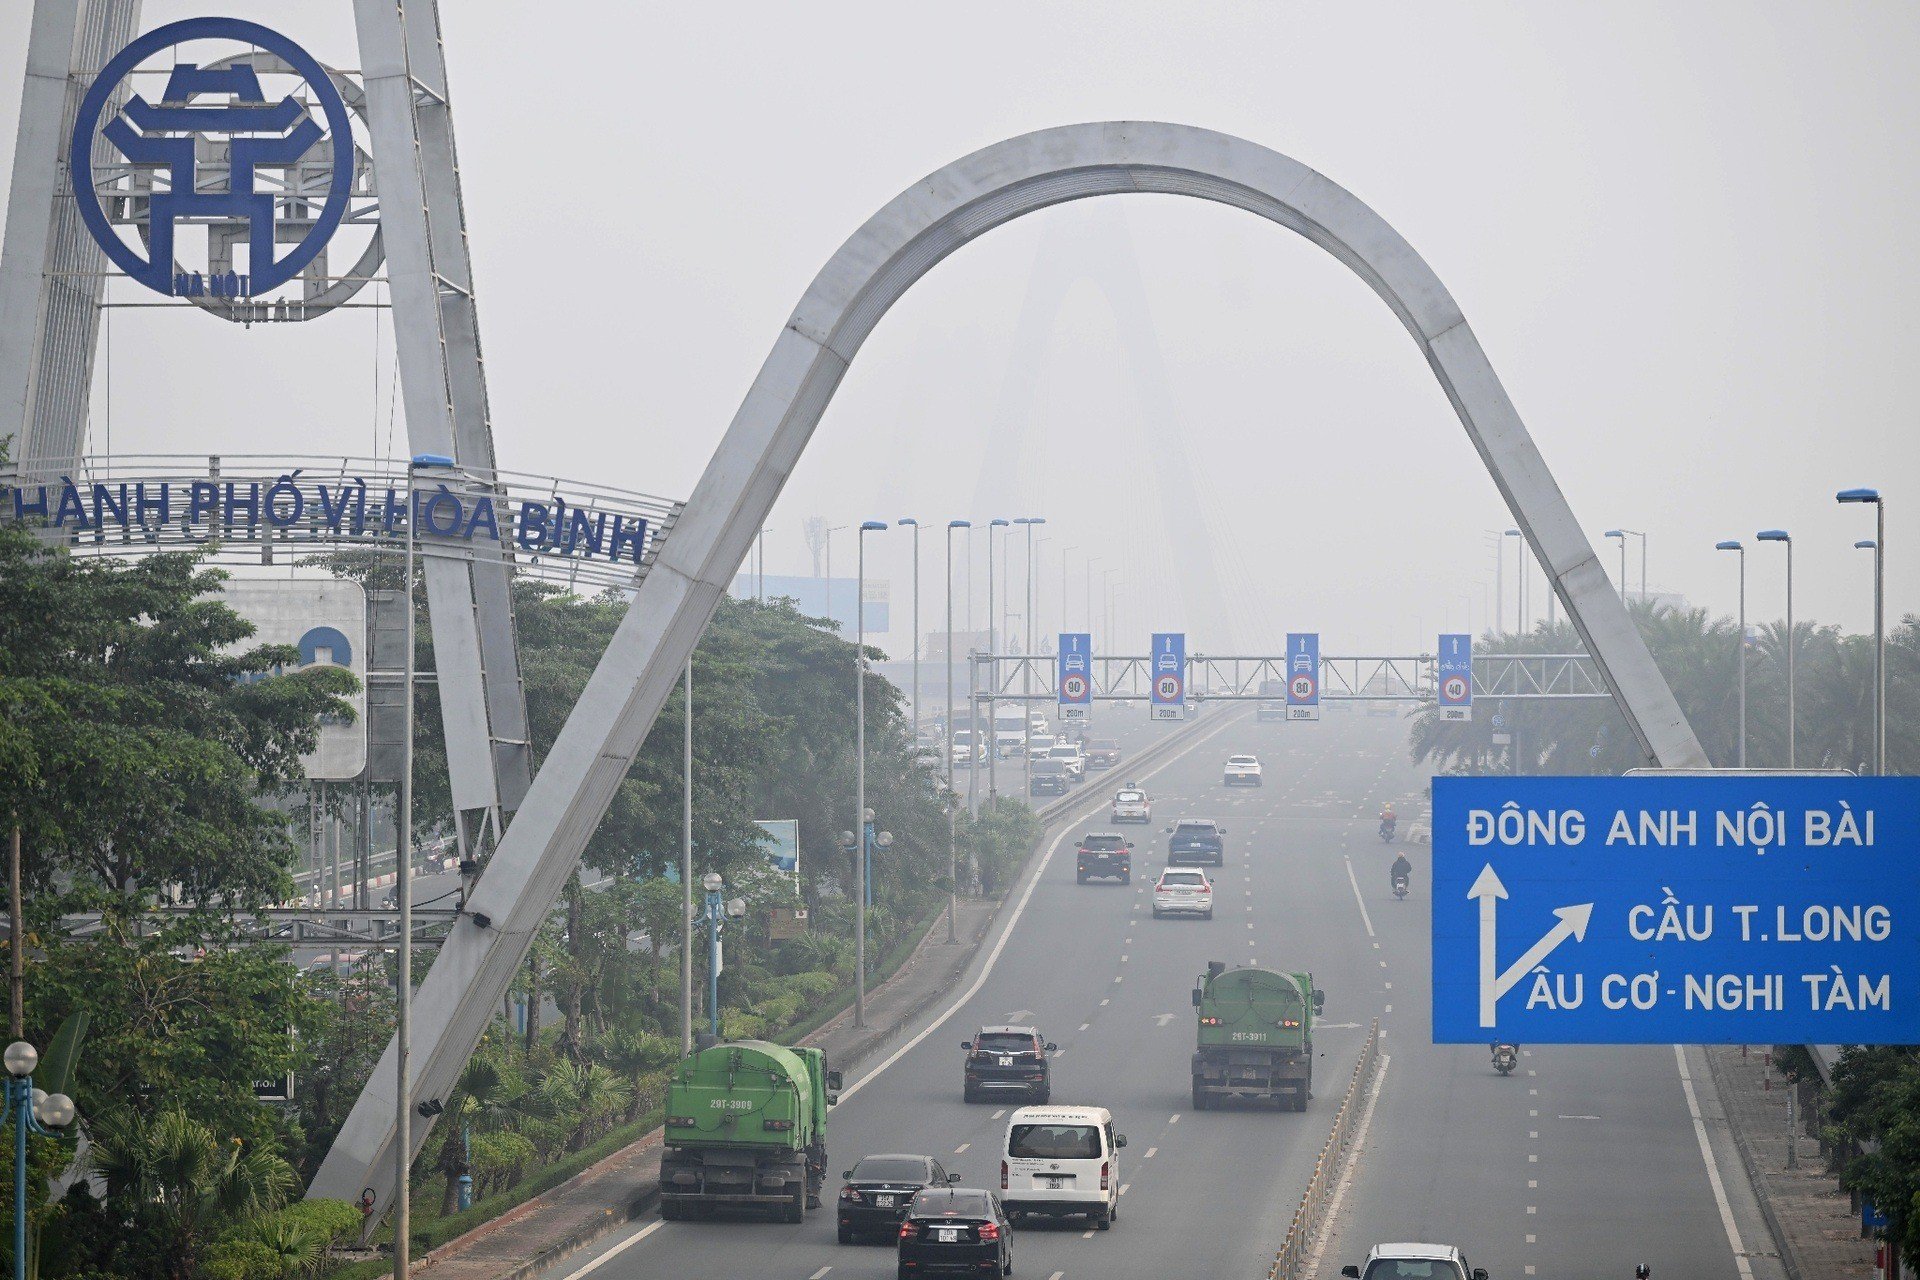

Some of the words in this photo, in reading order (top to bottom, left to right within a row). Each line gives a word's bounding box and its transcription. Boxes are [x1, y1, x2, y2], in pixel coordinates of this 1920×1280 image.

[0, 476, 170, 528] HÀNH
[190, 469, 304, 526] PHỐ
[317, 476, 366, 535] VÌ
[385, 484, 500, 541] HÒA
[519, 497, 648, 565] BÌNH
[1068, 681, 1081, 693] 90
[1161, 682, 1175, 694] 80
[1295, 682, 1309, 694] 80
[1448, 683, 1462, 695] 40
[1066, 709, 1084, 718] 200m
[1159, 709, 1177, 718] 200m
[1293, 710, 1311, 718] 200m
[1467, 801, 1586, 846] ĐÔNG
[1605, 810, 1697, 846] ANH
[1716, 801, 1786, 855] NỘI
[1805, 800, 1874, 846] BÀI
[1628, 886, 1713, 941] CẦU
[1732, 904, 1892, 941] T.LONG
[1525, 965, 1584, 1010] ÂU
[1801, 965, 1891, 1011] TÀM
[710, 1099, 753, 1110] 29T-3909
